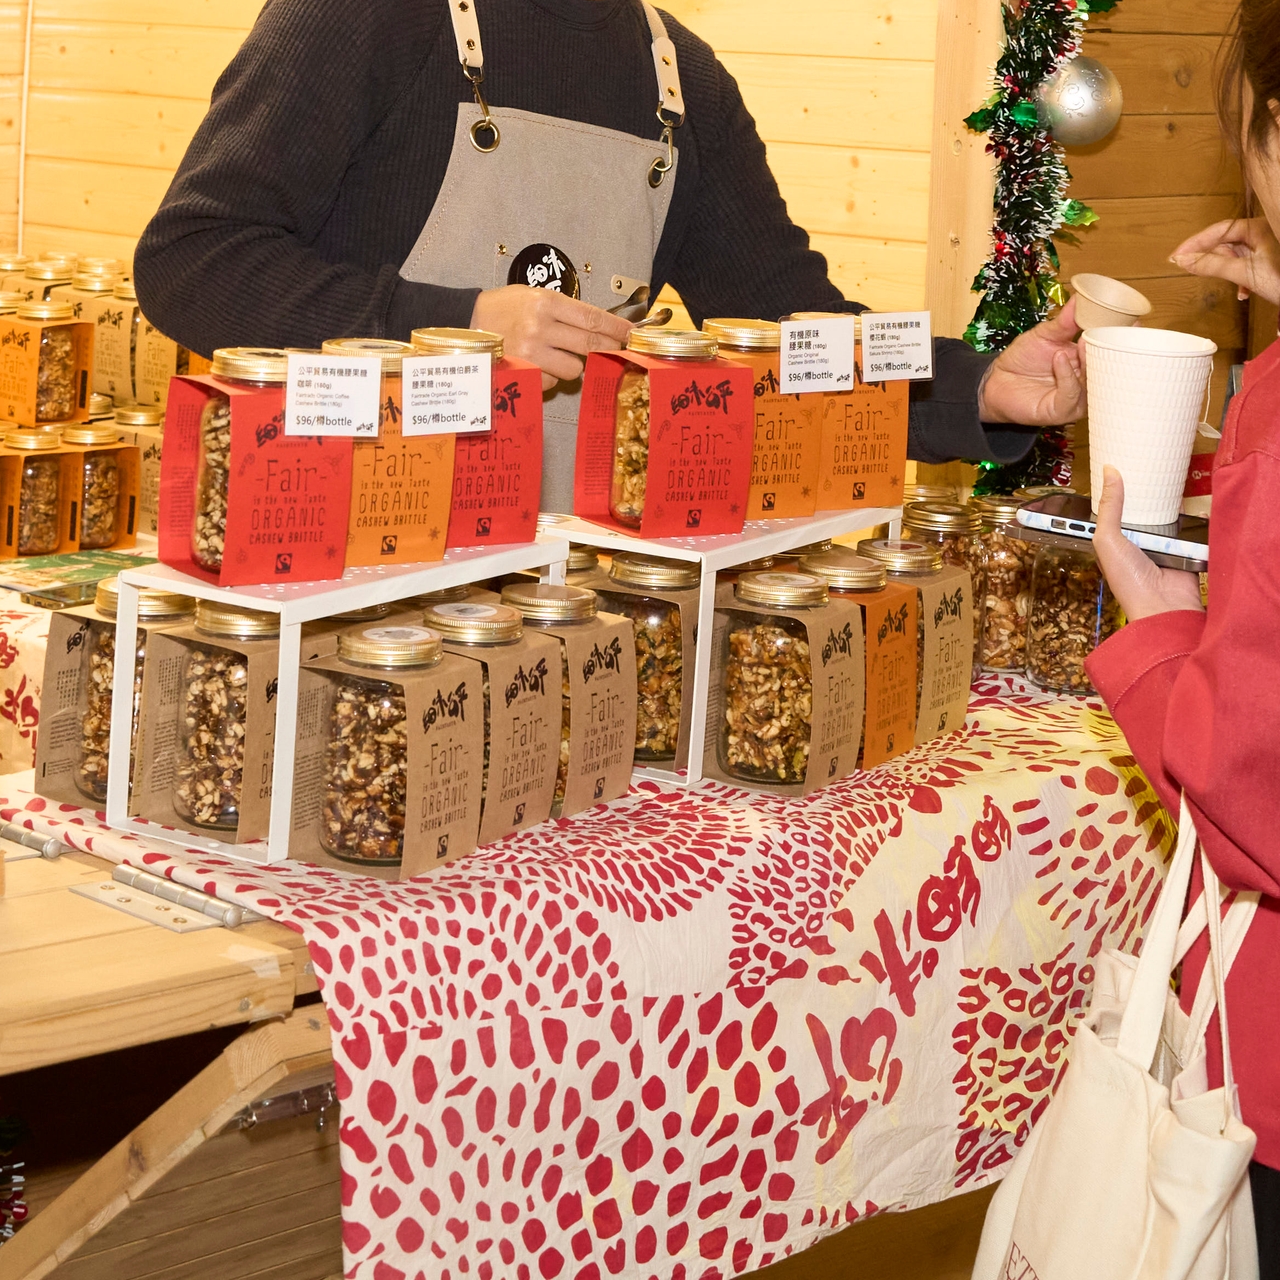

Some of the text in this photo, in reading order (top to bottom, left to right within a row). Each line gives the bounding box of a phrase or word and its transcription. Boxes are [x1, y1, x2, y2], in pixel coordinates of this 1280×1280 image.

[753, 453, 801, 472] RGANIC
[834, 443, 889, 463] ORGANIC
[668, 468, 731, 488] ORGANIC
[833, 464, 888, 475] CASHEW BRITTLE
[455, 475, 520, 497] ORGANIC
[752, 476, 768, 485] SHEW
[359, 491, 429, 514] ORGANIC
[666, 490, 728, 501] CASHEW BRITTLE
[252, 507, 326, 530] ORGANIC
[357, 514, 427, 528] CASHEW BRITTLE
[249, 531, 323, 545] CASHEW BRITTLE
[502, 755, 546, 789] ORGANIC
[422, 783, 468, 818] ORGANIC
